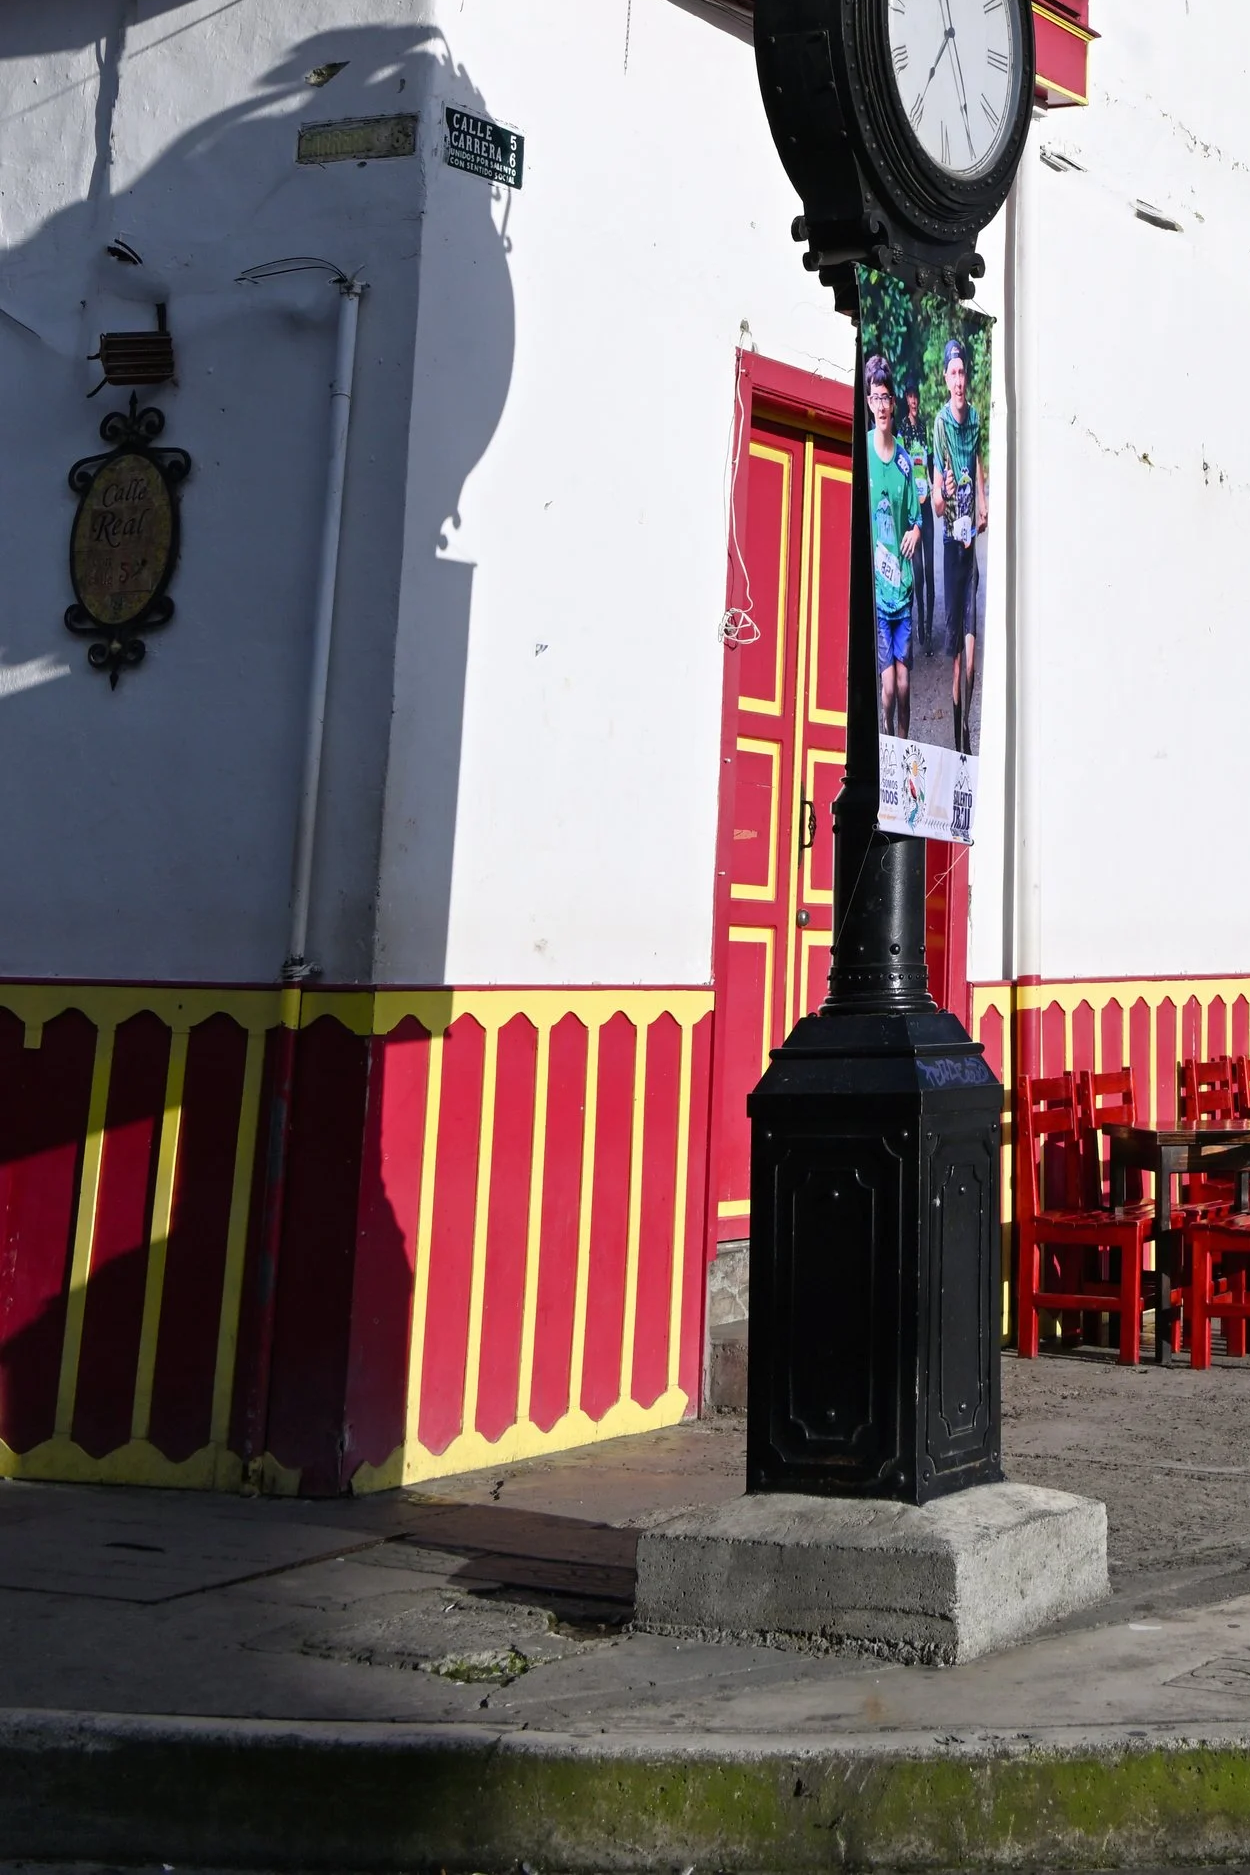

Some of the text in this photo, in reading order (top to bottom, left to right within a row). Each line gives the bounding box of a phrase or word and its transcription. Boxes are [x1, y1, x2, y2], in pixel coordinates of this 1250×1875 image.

[452, 113, 517, 151] CALLE 5
[451, 131, 516, 168] CARRERA 6
[476, 155, 489, 167] POR
[490, 161, 517, 176] SALENTO
[449, 156, 515, 185] CON SENTIDO SOCIAL
[102, 478, 147, 508] Calle
[92, 508, 151, 548] Real
